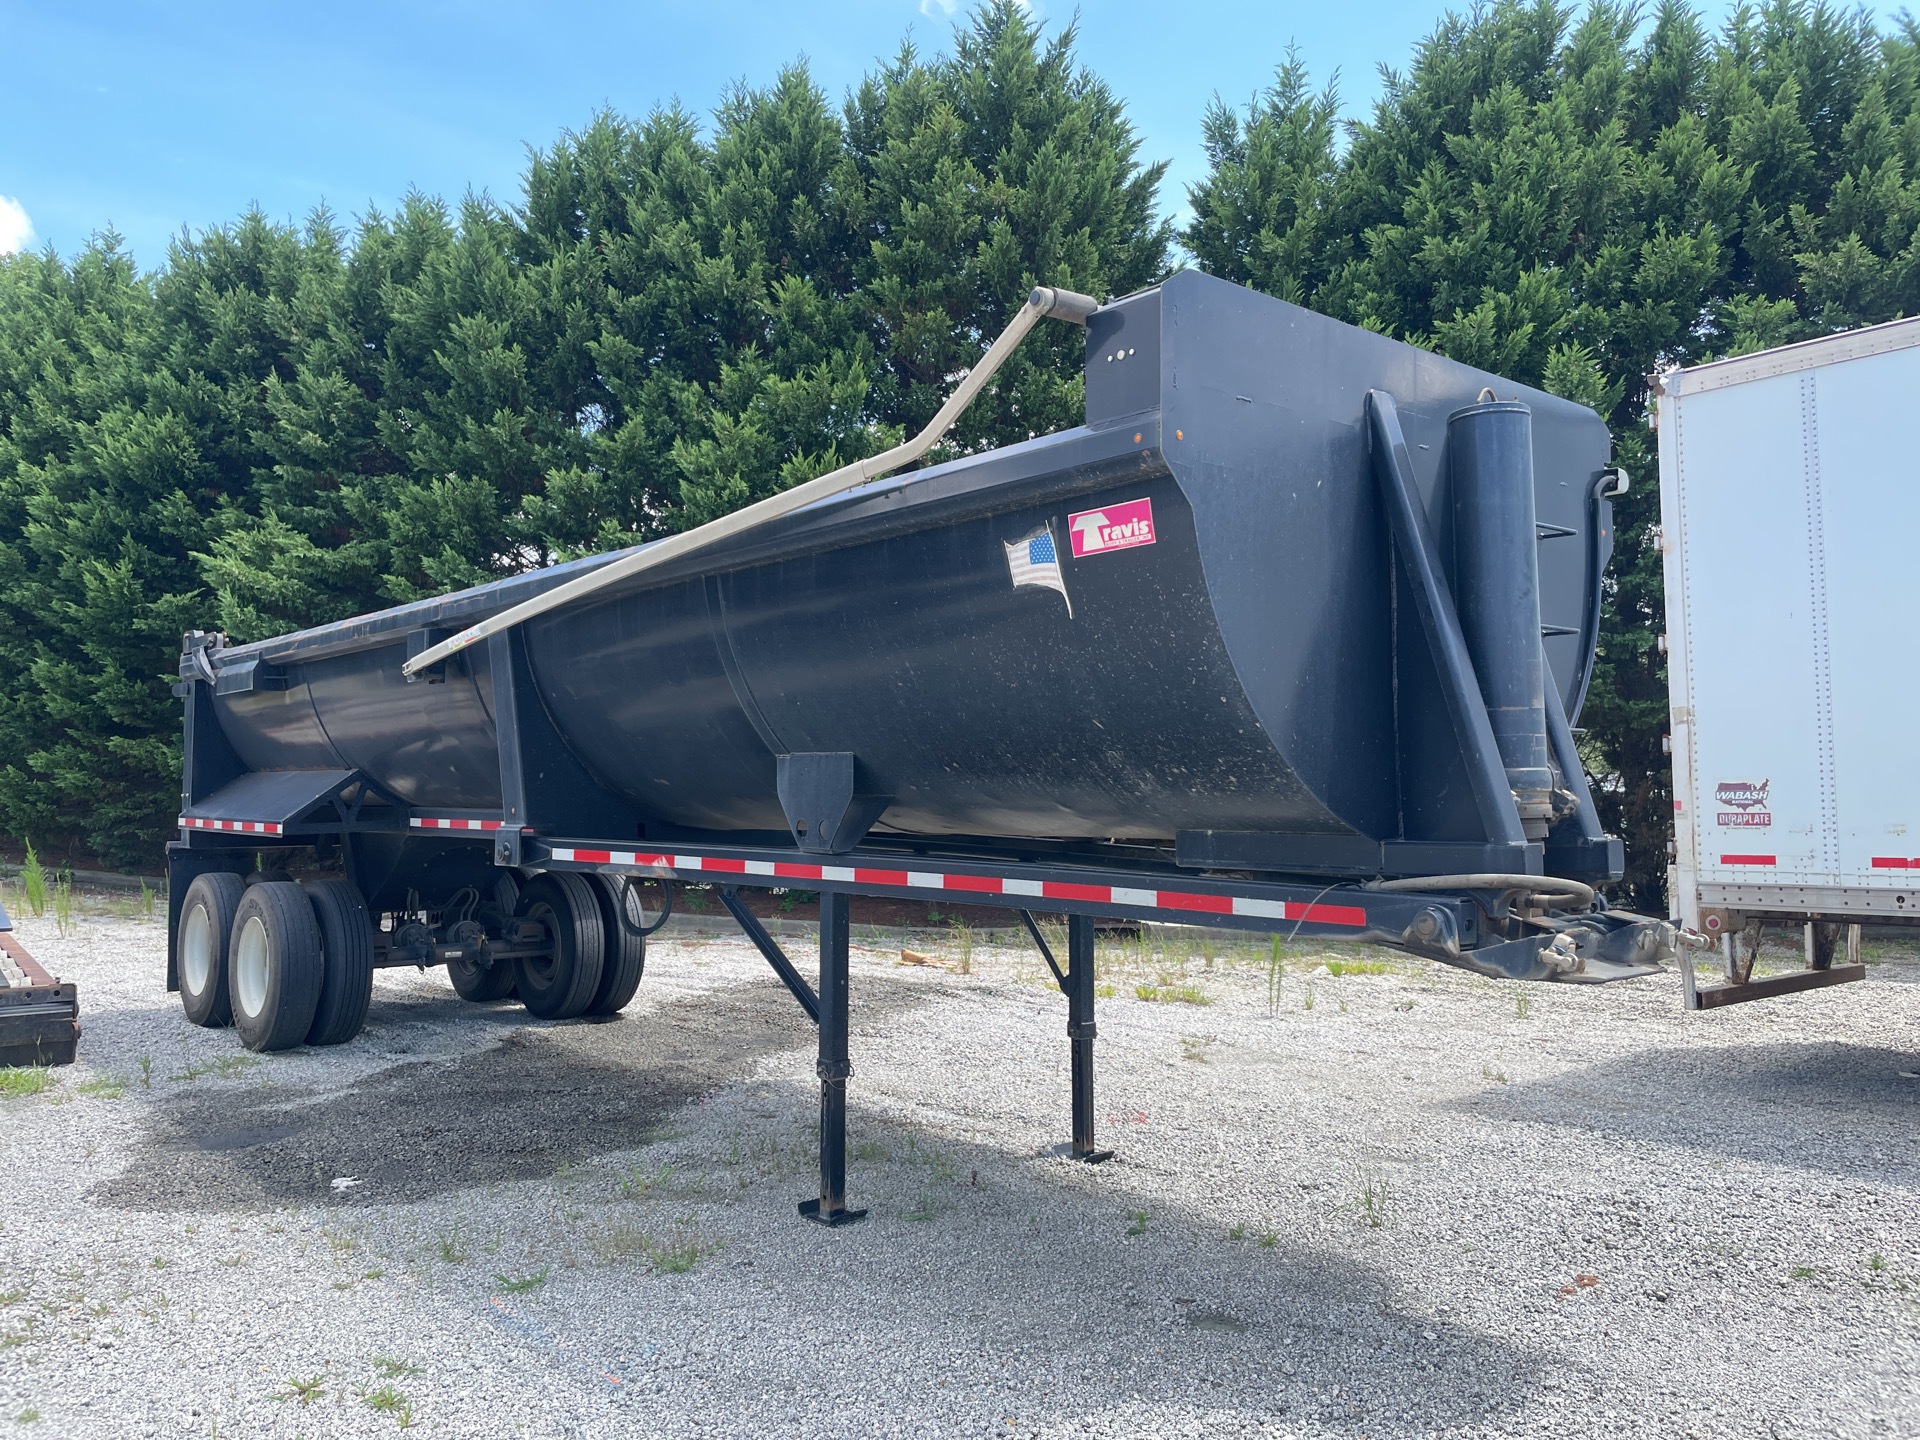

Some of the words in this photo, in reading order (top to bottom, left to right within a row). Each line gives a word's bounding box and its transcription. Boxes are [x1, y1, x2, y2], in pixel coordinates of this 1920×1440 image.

[1072, 512, 1149, 552] Travis
[1716, 791, 1768, 800] WABASH
[1719, 814, 1770, 824] DURAPLATE
